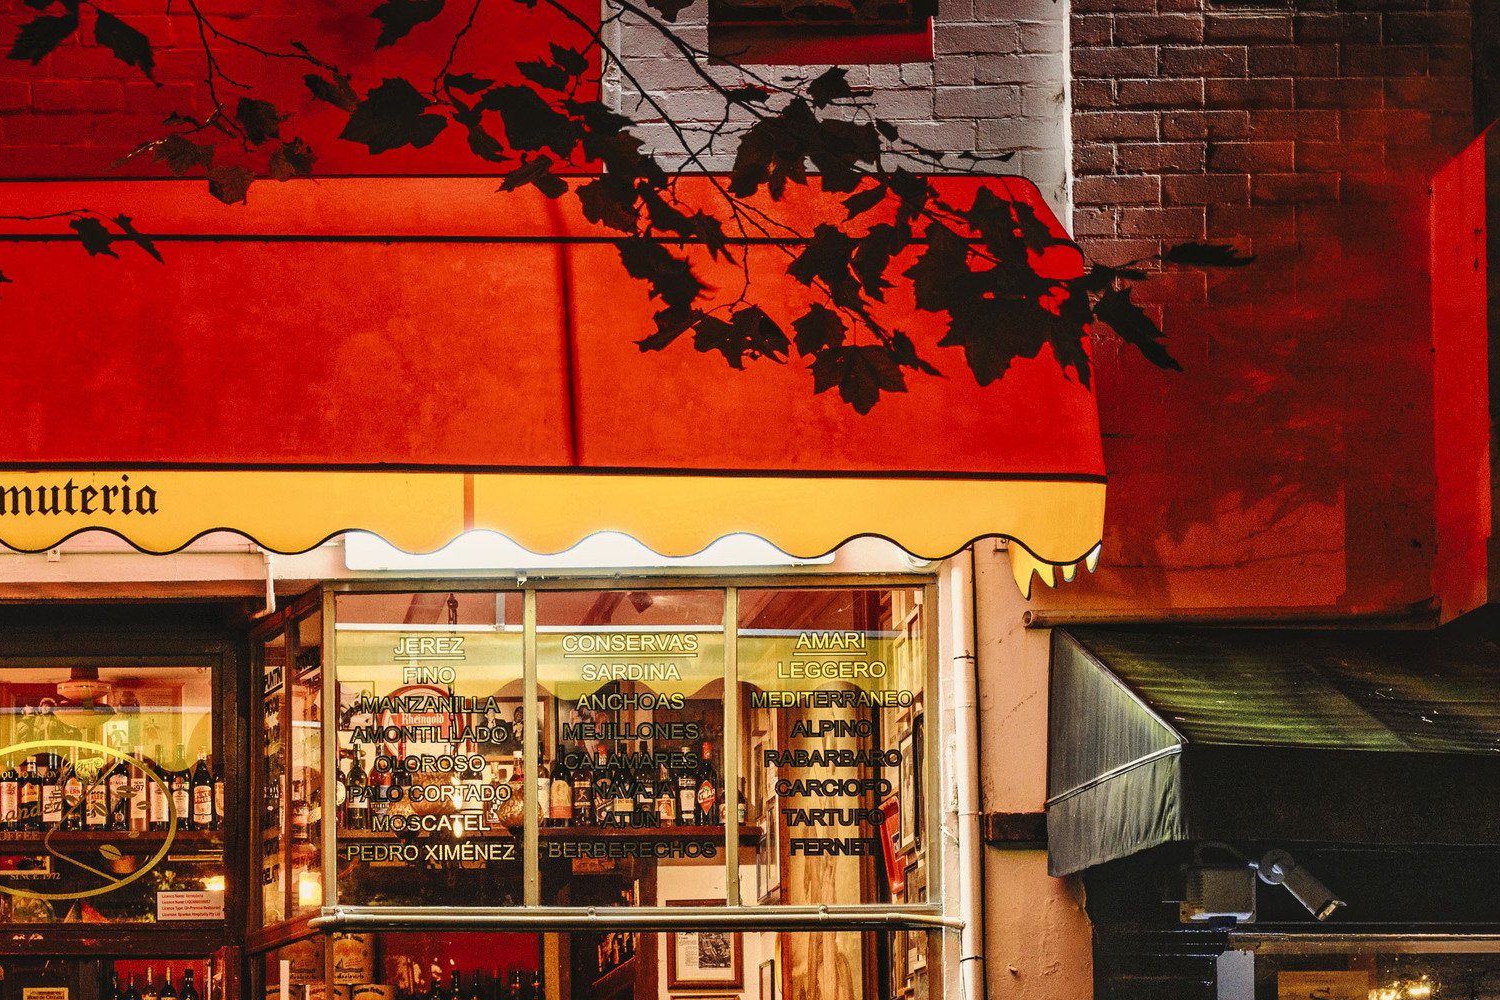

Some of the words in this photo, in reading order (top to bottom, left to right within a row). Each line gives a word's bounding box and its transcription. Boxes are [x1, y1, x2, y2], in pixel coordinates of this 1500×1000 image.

[393, 636, 465, 655] JEREZ
[562, 633, 698, 653] CONSERVAS
[796, 632, 866, 649] AMARI
[403, 666, 456, 684] FINO
[581, 663, 681, 682] SARDINA
[777, 661, 886, 679] LEGGERO
[361, 696, 500, 713] MANZANILLA
[575, 692, 686, 711] ANCHOAS
[751, 690, 914, 708] MEDITERRANEO
[401, 713, 445, 725] Rheingold
[350, 726, 508, 743] AMONTILLADO
[563, 722, 699, 740] MEJILLONES
[791, 720, 873, 737] ALPINO
[374, 755, 486, 773] OLOROSO
[564, 752, 699, 769] CALAMARES
[764, 750, 902, 767] RABARBARO
[348, 784, 404, 802] PALO
[408, 784, 512, 802] CORTADO
[592, 781, 675, 799] NAVAJA
[775, 779, 892, 797] CARCIOFO
[371, 814, 491, 832] MOSCATEL
[601, 808, 661, 829] ATÚN
[782, 809, 885, 826] TARTUFO
[346, 843, 419, 862] PEDRO
[423, 838, 515, 862] XIMÉNEZ
[548, 841, 717, 859] BERBERECHOS
[790, 838, 878, 856] FERNET
